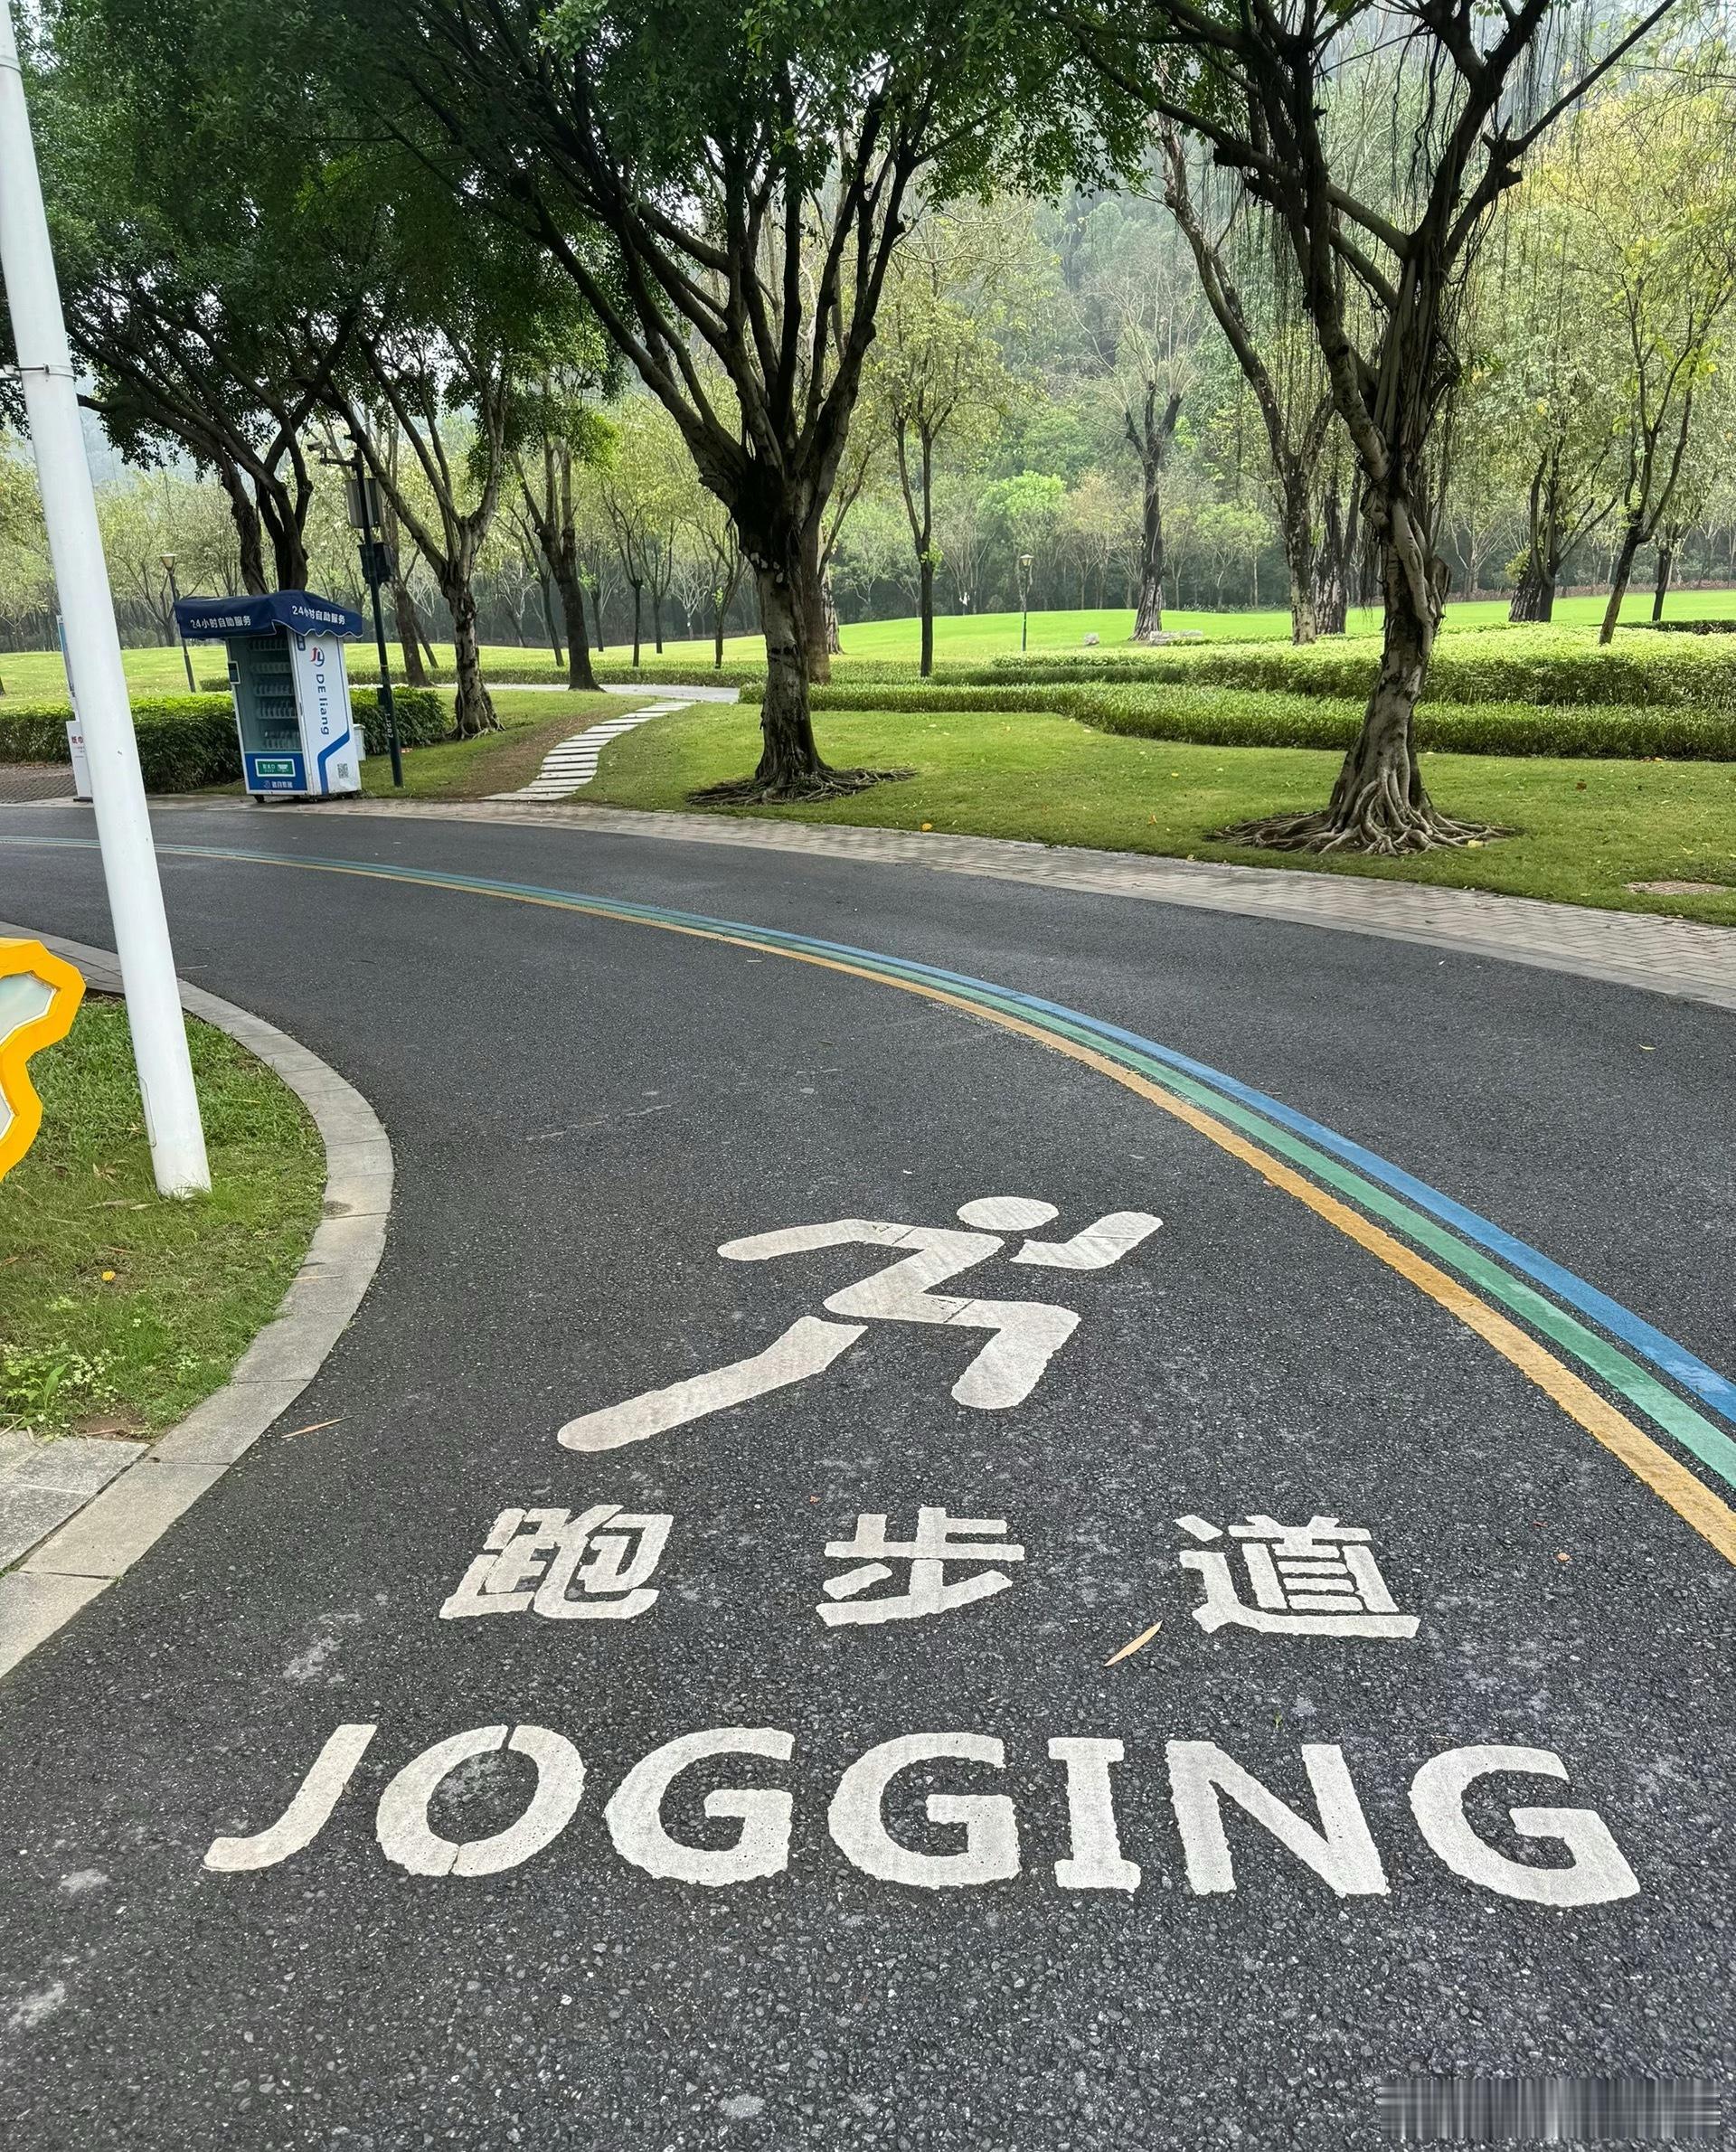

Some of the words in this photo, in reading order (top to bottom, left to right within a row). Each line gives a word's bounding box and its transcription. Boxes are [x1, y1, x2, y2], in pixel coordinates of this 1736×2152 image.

[190, 615, 251, 629] 24小时自助服务
[291, 605, 346, 626] 24小时自助服务
[434, 1503, 1423, 1639] 跑步道
[202, 1722, 1642, 1909] JOGGING
